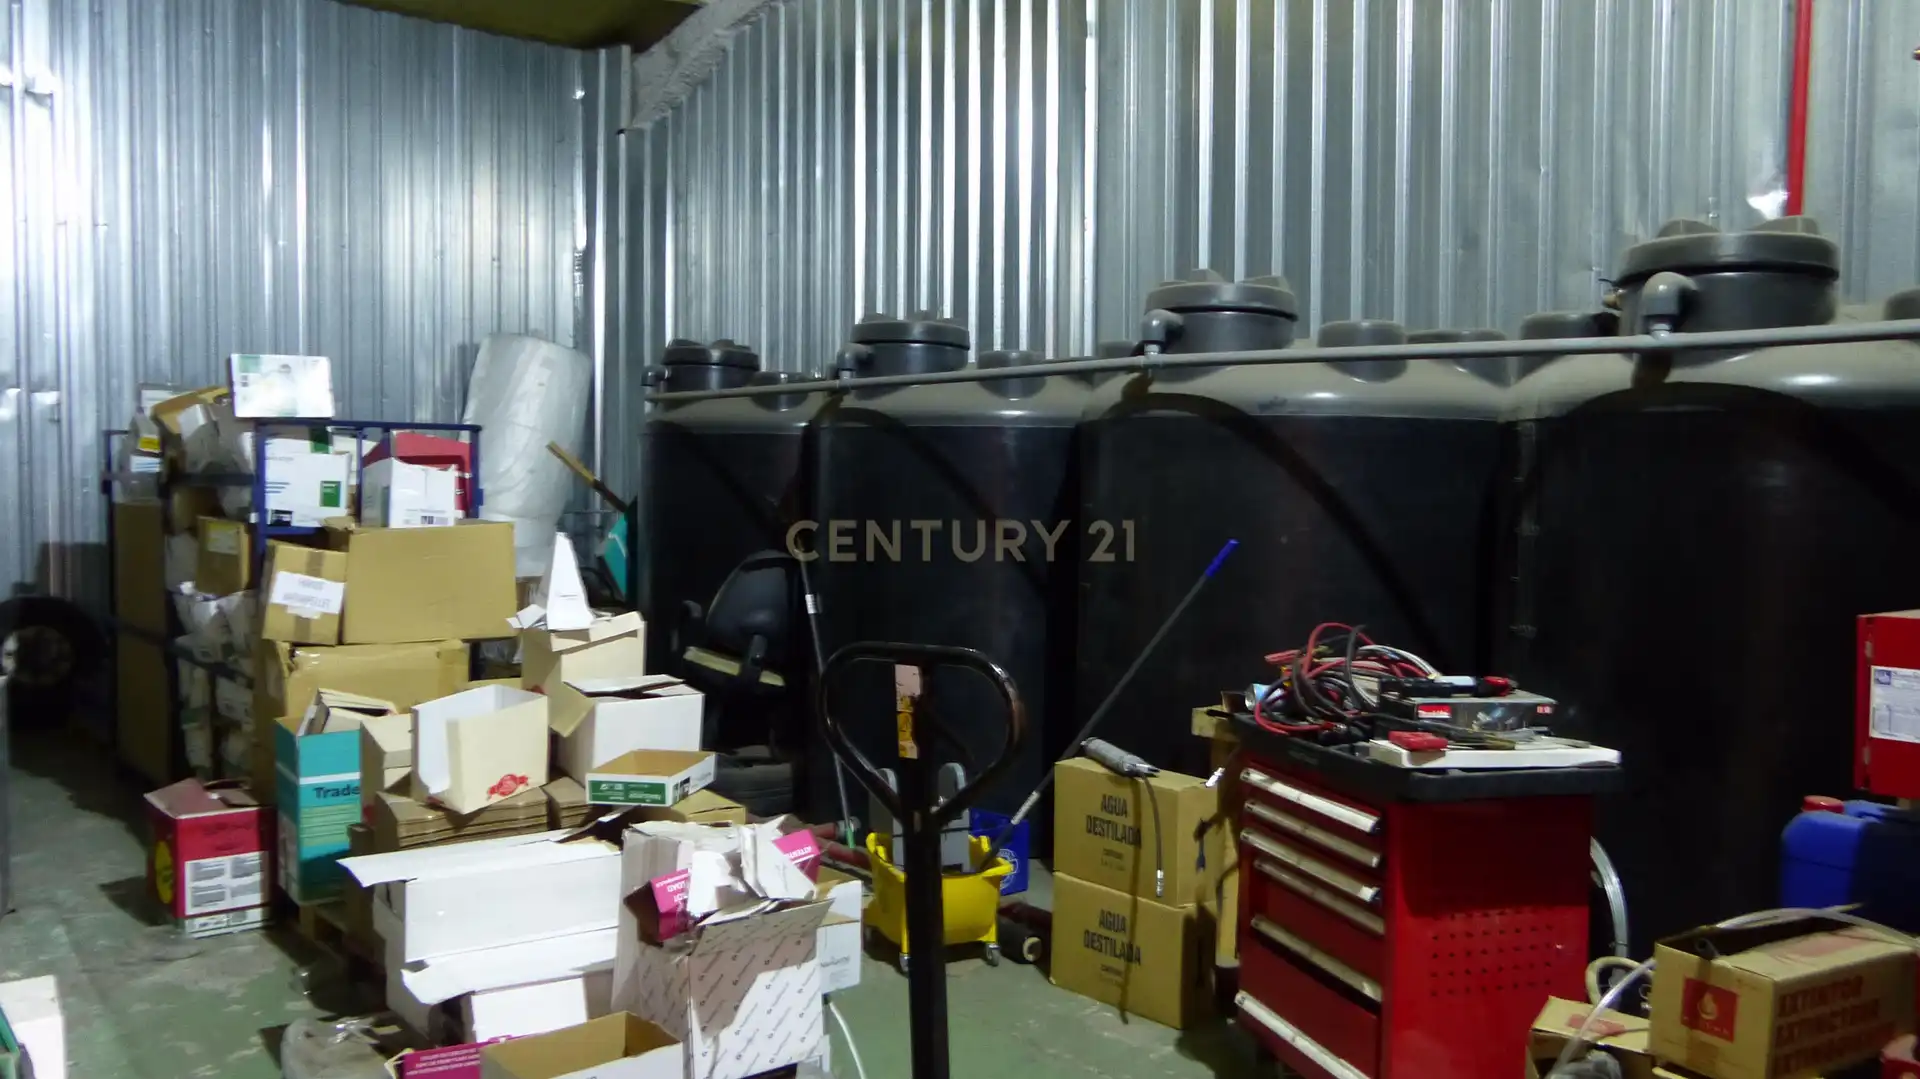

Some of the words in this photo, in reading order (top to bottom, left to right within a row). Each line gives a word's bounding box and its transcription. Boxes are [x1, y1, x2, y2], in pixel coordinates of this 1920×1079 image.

[313, 784, 361, 799] Trade
[1101, 794, 1128, 818] AGUA
[1085, 815, 1142, 846] DESTILADA
[1098, 909, 1127, 934] AGUA
[1083, 930, 1142, 966] DESTILADA
